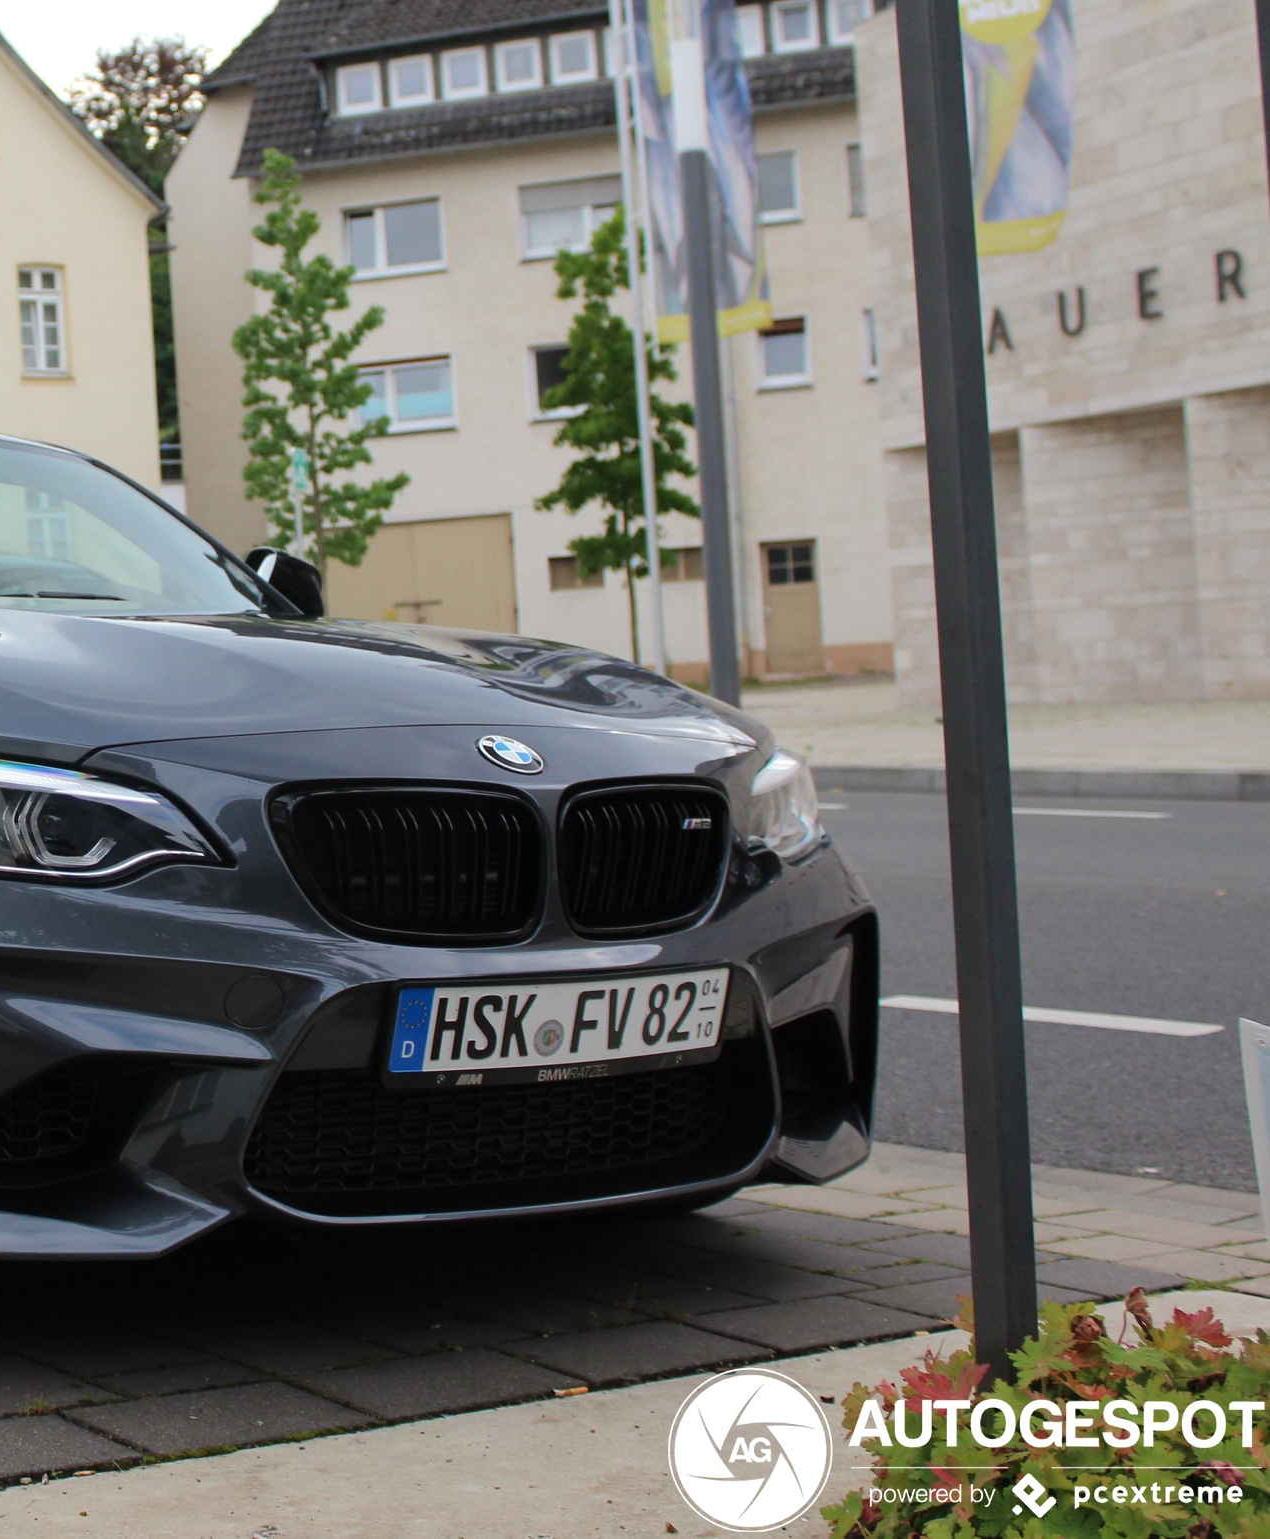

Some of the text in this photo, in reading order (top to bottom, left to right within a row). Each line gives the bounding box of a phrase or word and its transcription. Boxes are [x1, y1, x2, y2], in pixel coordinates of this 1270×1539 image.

[701, 978, 720, 996] 04
[430, 981, 698, 1061] HSK FV 82
[696, 1022, 713, 1039] 10
[401, 1041, 415, 1058] D
